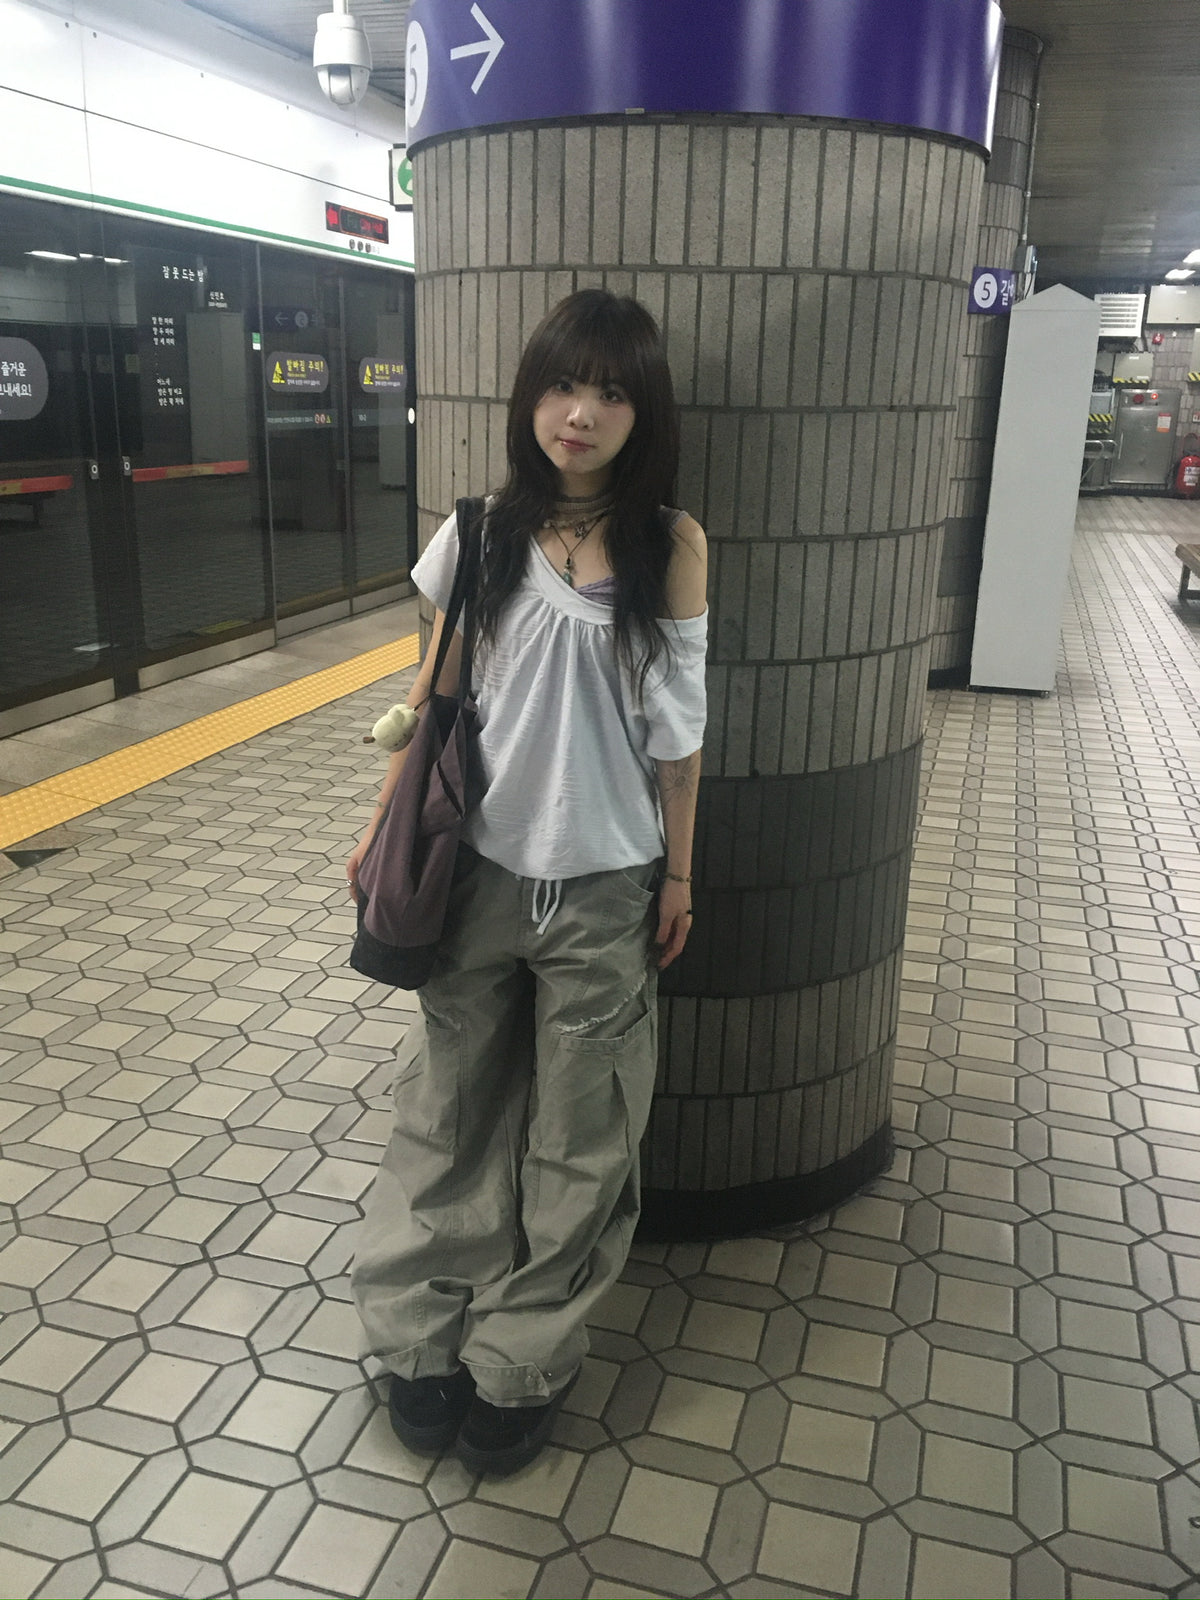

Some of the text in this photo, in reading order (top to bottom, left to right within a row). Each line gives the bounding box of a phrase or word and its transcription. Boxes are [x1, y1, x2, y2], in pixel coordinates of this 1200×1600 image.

[409, 43, 418, 107] 5
[162, 265, 204, 283] 잠 못 드는 밤
[981, 280, 992, 301] 5
[0, 361, 27, 377] 즐거운
[286, 359, 324, 373] 발빠짐 주의!
